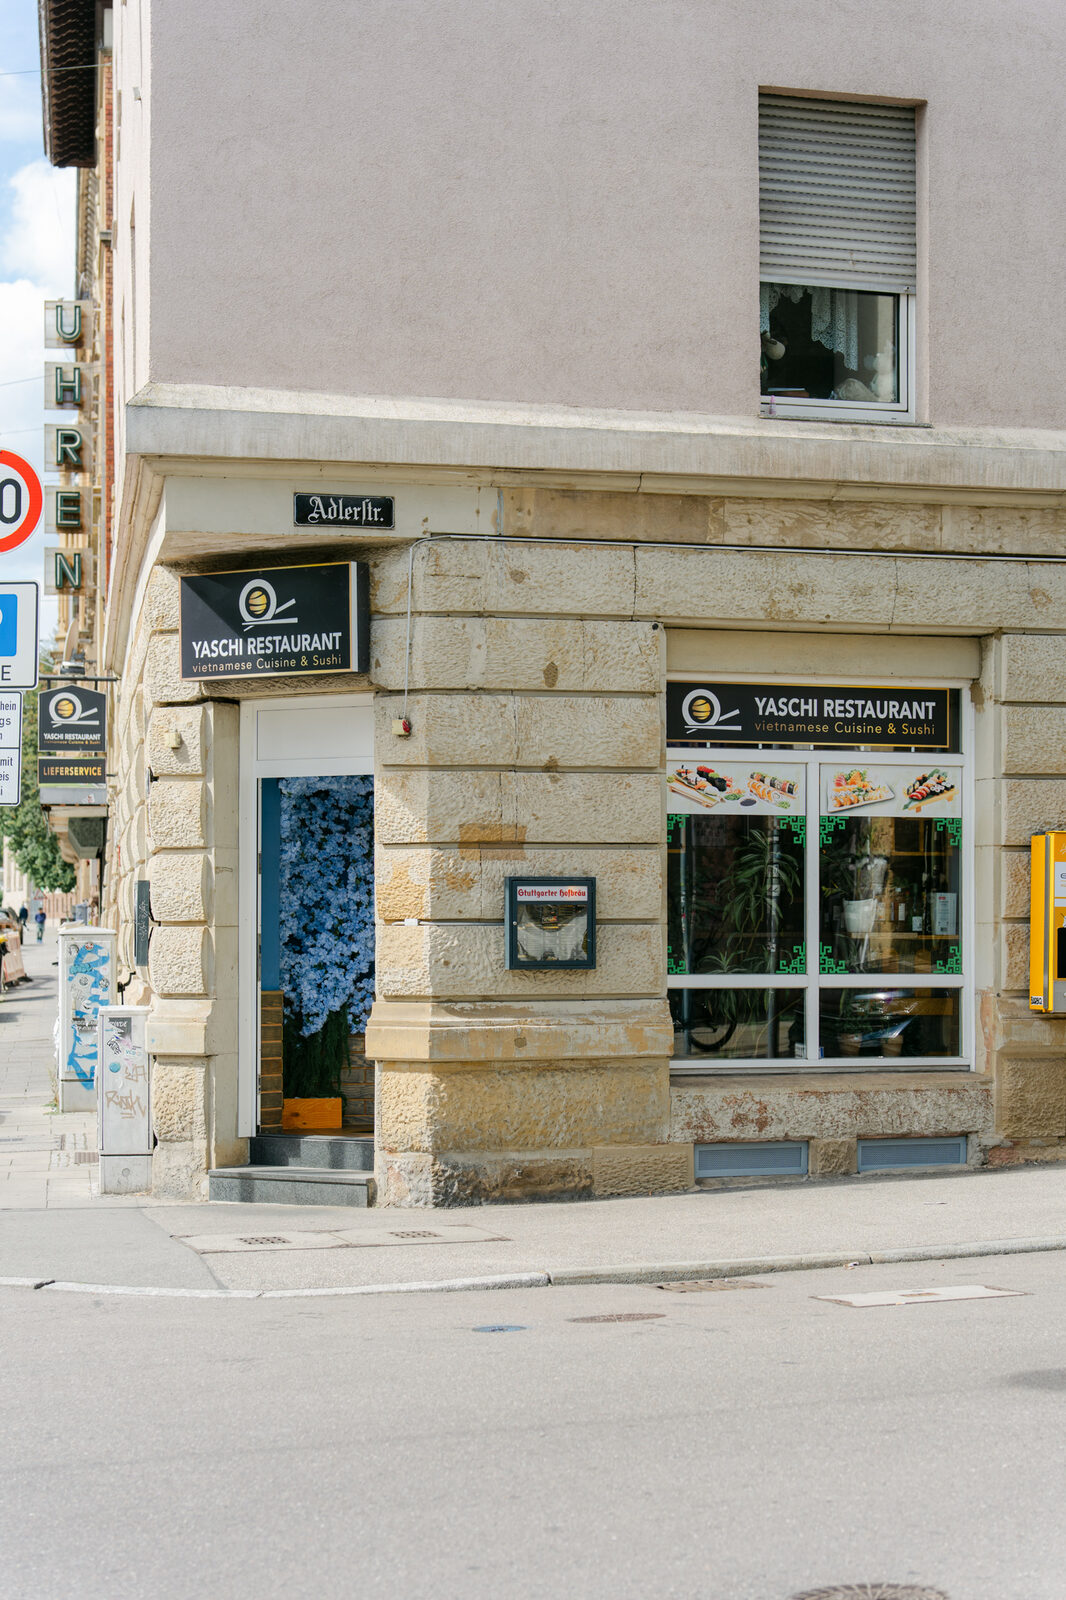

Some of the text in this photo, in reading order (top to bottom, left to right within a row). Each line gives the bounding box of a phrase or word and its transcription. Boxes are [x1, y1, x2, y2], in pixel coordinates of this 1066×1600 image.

[191, 631, 342, 659] YASCHI RESTAURANT
[192, 653, 342, 673] vietnamese Cuisine & Sushi
[754, 697, 936, 720] YASCHI RESTAURANT
[43, 732, 64, 740] YASCHI
[754, 720, 935, 735] vietnamese Cuisine & Sushi
[43, 766, 102, 776] LIEFERSERVICE
